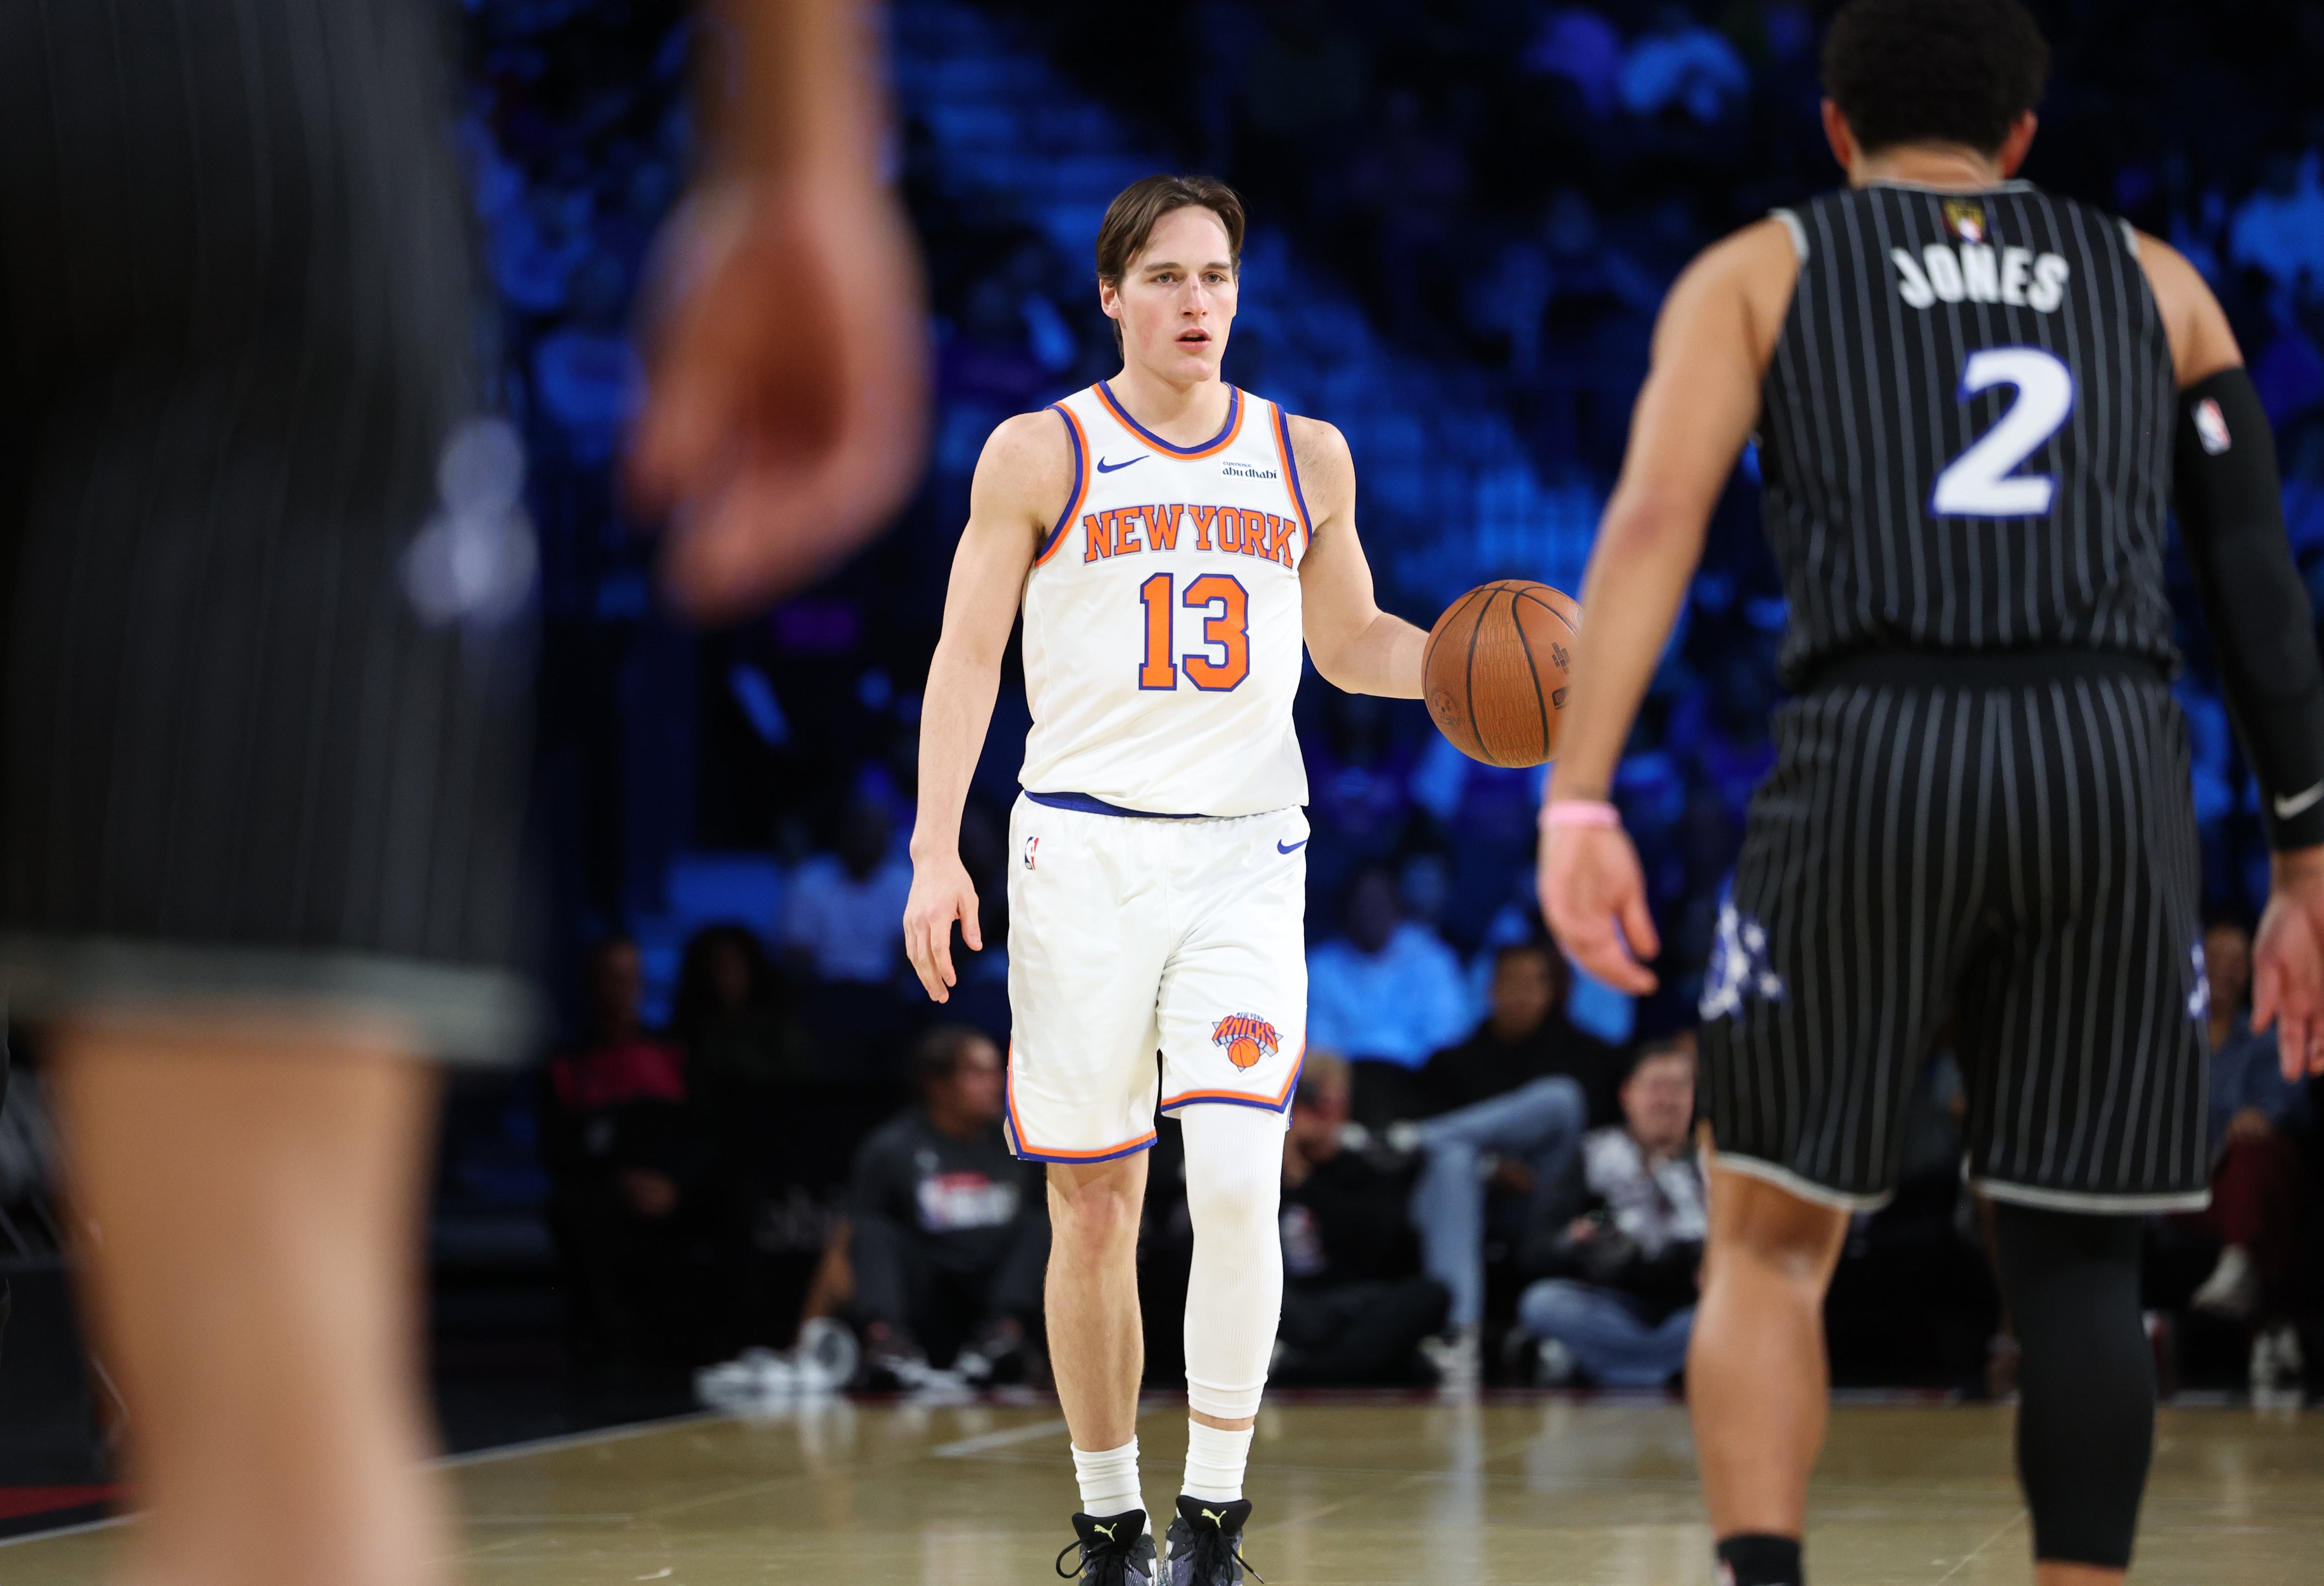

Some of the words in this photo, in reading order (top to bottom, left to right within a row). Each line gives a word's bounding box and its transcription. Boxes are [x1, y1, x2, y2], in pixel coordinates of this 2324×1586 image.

[1890, 242, 2070, 313] JONES
[1928, 345, 2076, 520] 2
[1223, 467, 1243, 476] abu
[1082, 503, 1184, 565] NEW
[1188, 504, 1297, 570] YORK
[1139, 572, 1250, 692] 13
[1212, 1015, 1278, 1055] KNICKS
